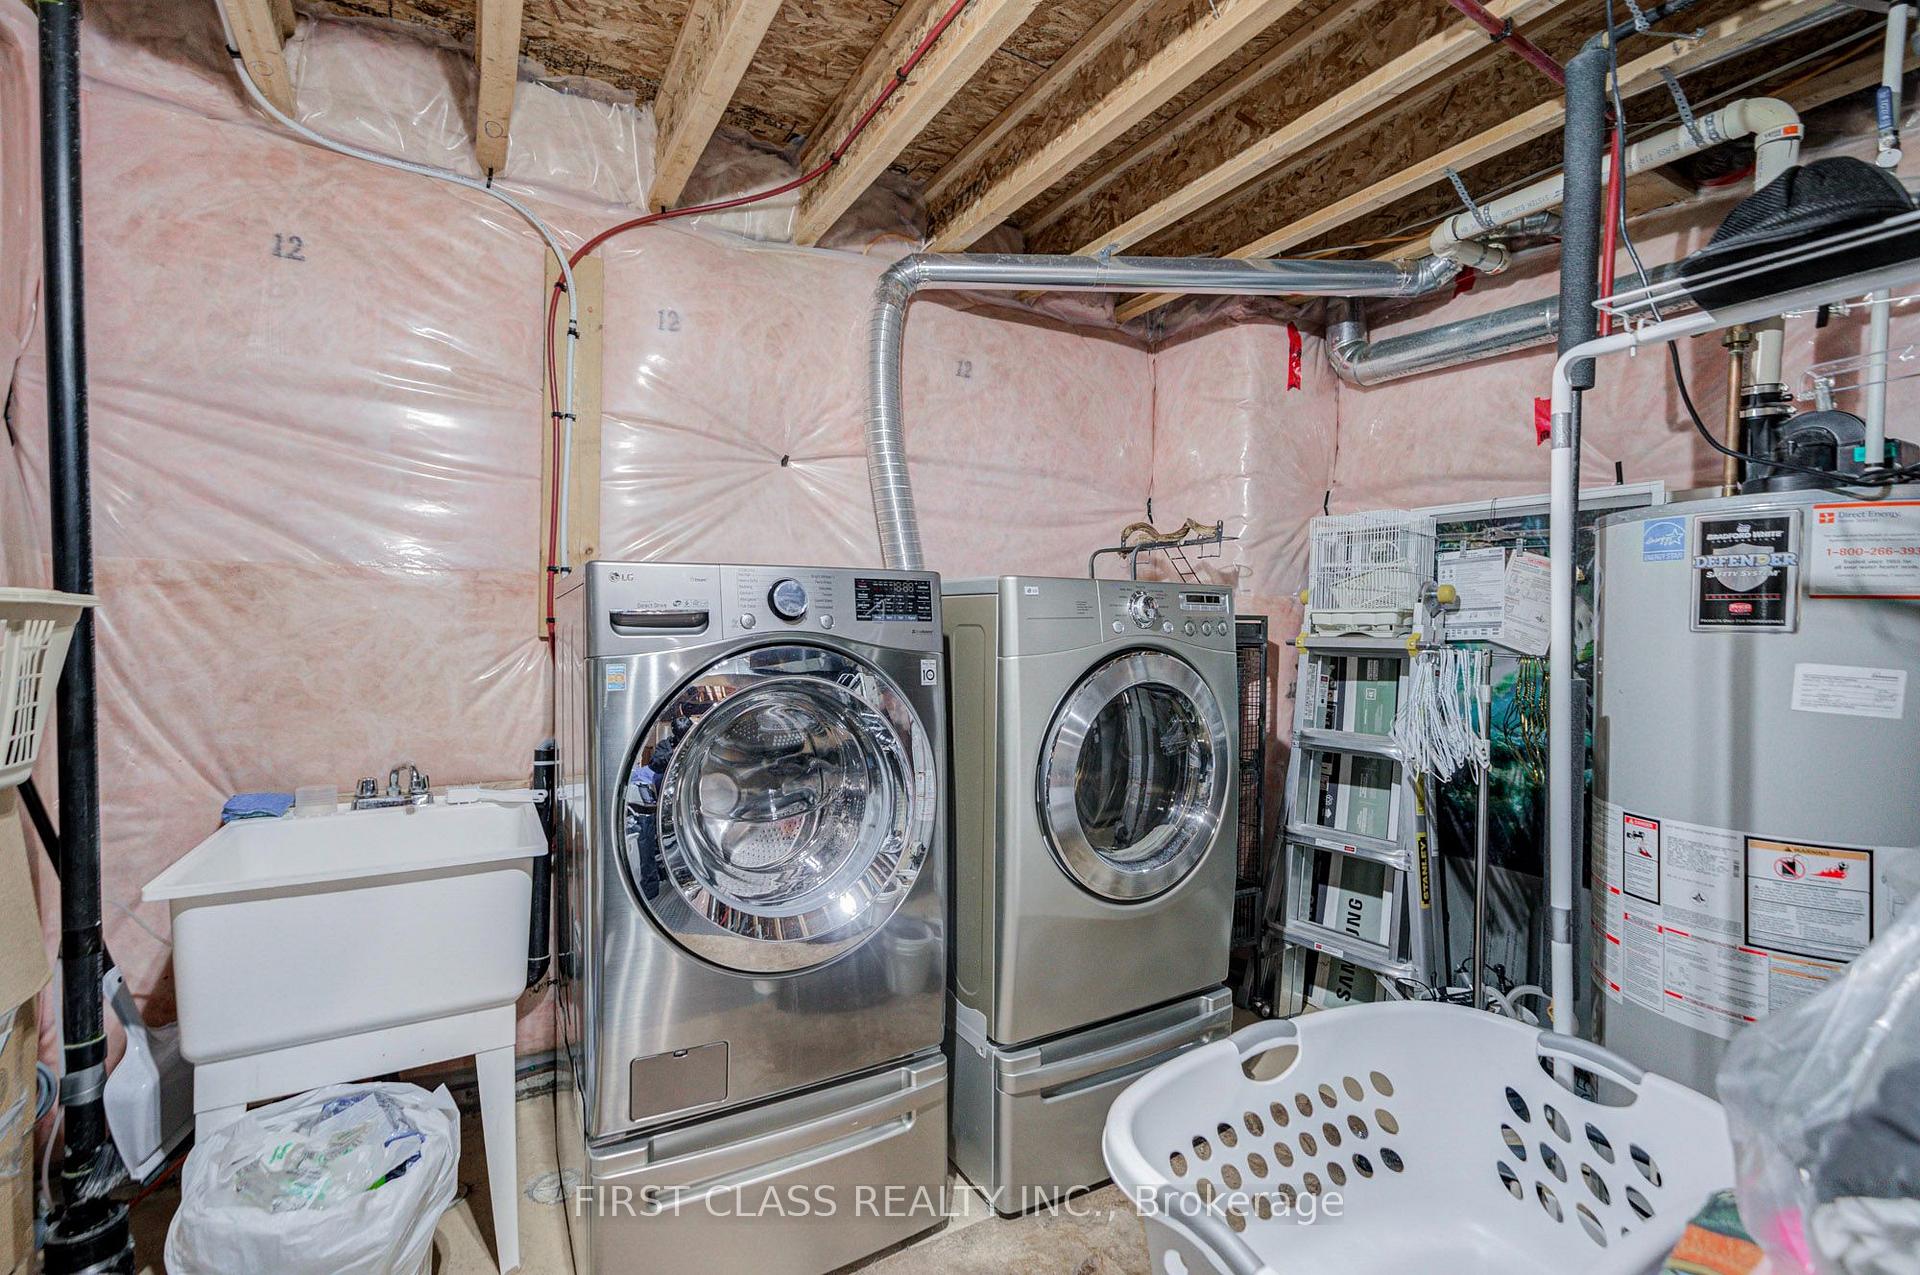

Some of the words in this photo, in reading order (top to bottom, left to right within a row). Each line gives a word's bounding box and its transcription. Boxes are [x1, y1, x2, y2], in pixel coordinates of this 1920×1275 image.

[272, 232, 306, 262] 12
[657, 309, 681, 332] 12
[1838, 511, 1865, 519] Direct
[1706, 531, 1752, 541] BRADFORD
[1693, 551, 1798, 569] DEFENDER
[621, 573, 634, 582] LG
[1420, 842, 1430, 900] STANLEY
[1336, 897, 1363, 1002] SAMUNG
